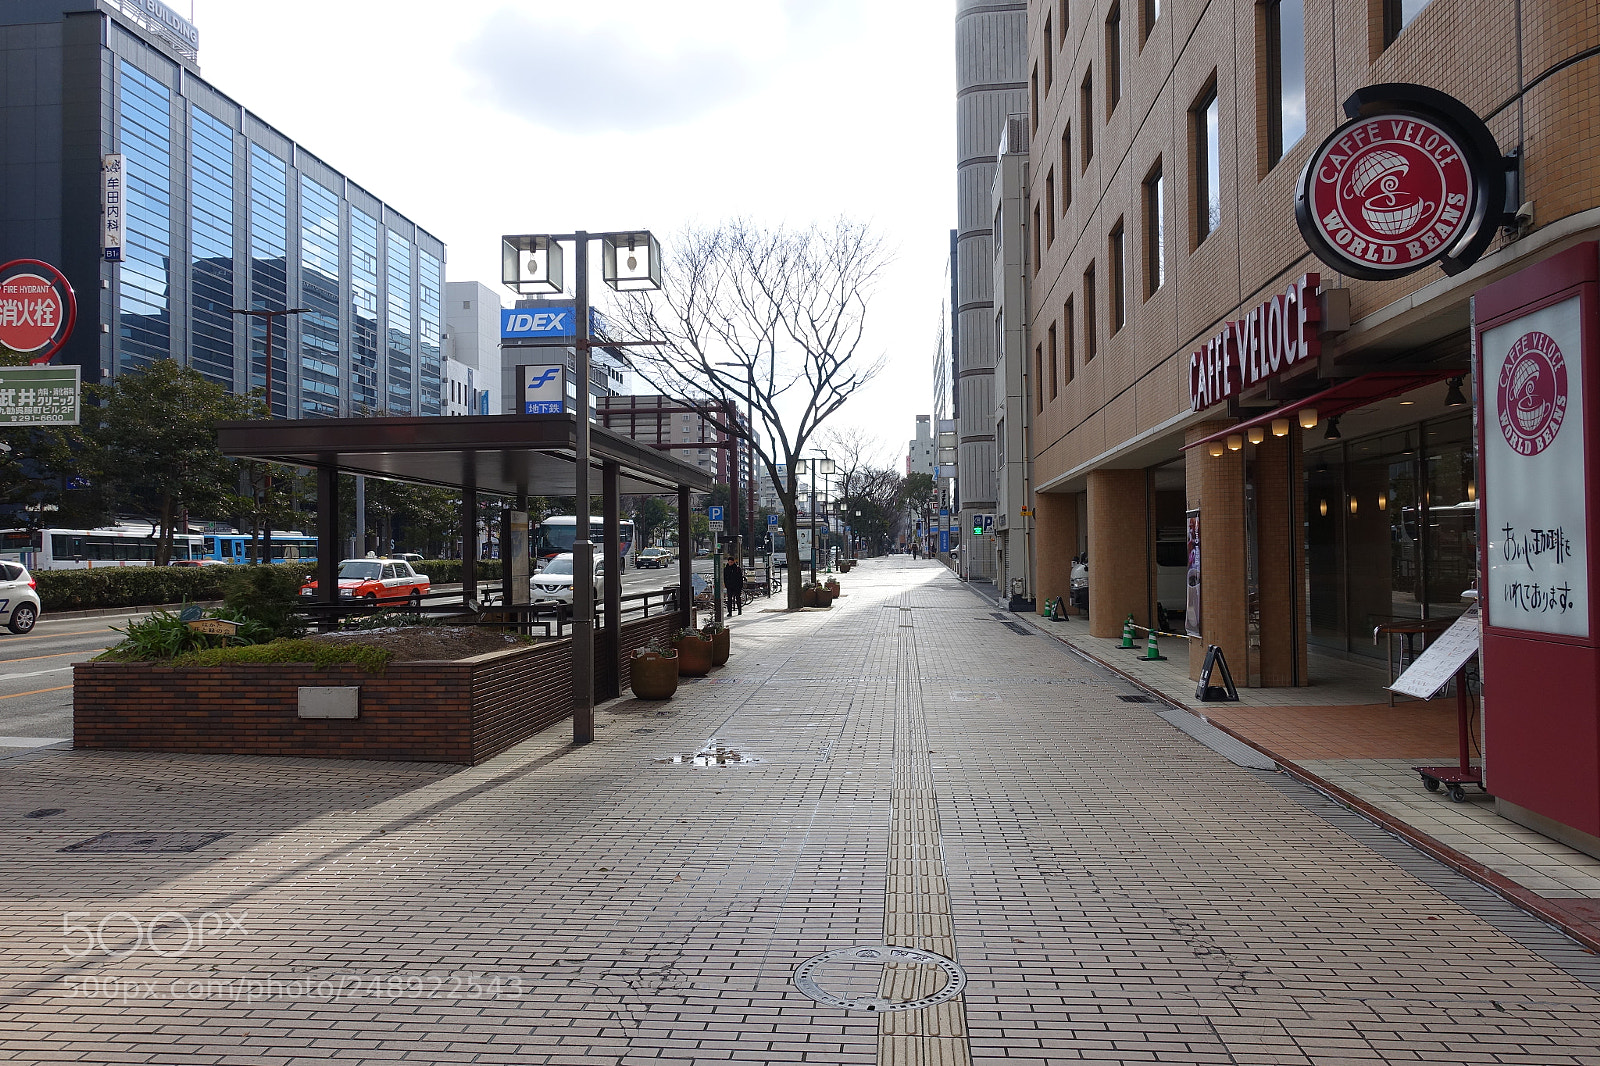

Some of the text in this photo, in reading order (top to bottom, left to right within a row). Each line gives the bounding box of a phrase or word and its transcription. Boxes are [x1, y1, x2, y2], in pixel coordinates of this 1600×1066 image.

[146, 0, 197, 43] BUILDING
[1391, 121, 1459, 168] VELOCE
[107, 177, 120, 232] 牟田内科
[1322, 192, 1466, 263] WORLD BEANS
[20, 285, 50, 294] HYDRANT
[0, 298, 56, 327] 消火栓
[506, 312, 567, 332] IDEX
[1235, 272, 1308, 389] VELOCE
[1532, 333, 1564, 372] VELOCE
[0, 388, 36, 406] 武井
[37, 396, 74, 406] クリニック
[528, 403, 560, 414] 地下鉄
[1501, 394, 1568, 455] WORLD BEANS
[712, 508, 720, 520] P
[1504, 581, 1574, 614] いれております。
